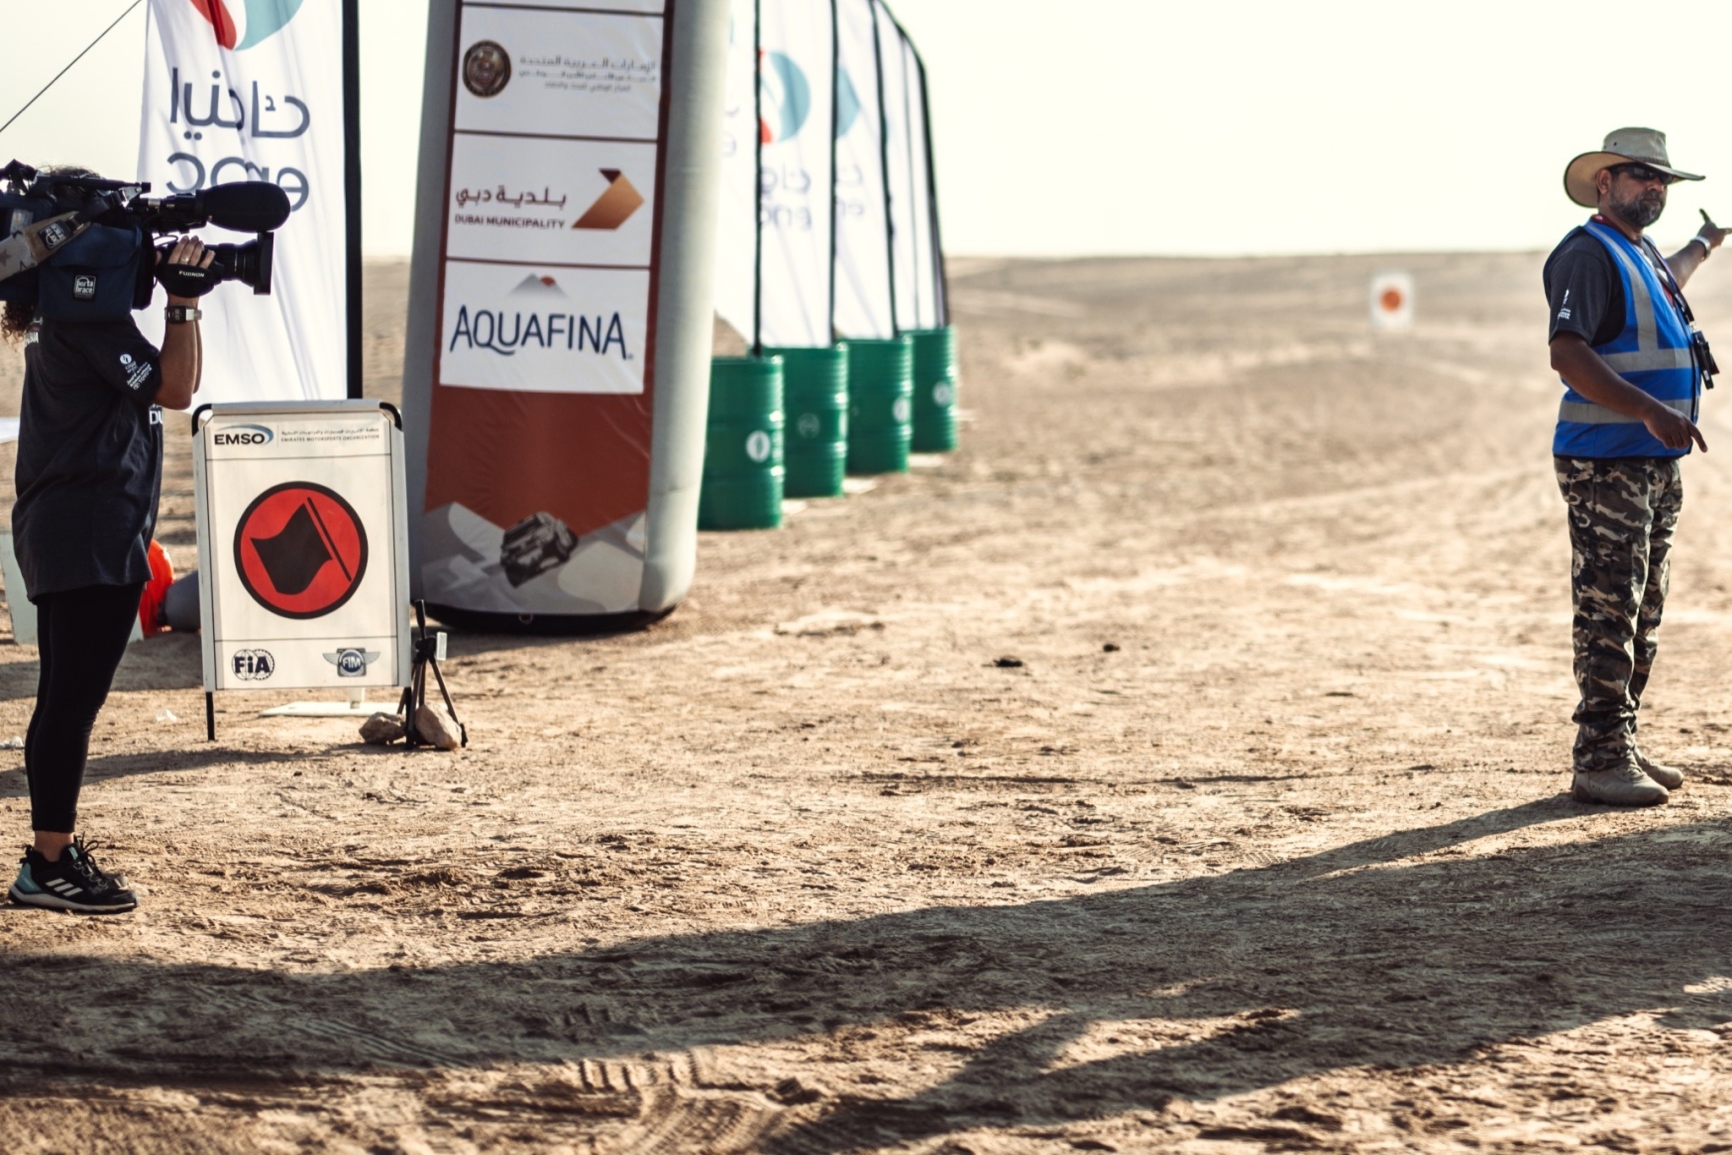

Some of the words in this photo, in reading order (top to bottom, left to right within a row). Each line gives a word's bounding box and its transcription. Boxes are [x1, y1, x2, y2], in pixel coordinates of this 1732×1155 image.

[455, 213, 483, 225] DUBAI
[487, 215, 565, 229] MUNICIPALITY
[450, 304, 628, 361] AQUAFINA
[214, 433, 265, 445] EMSO
